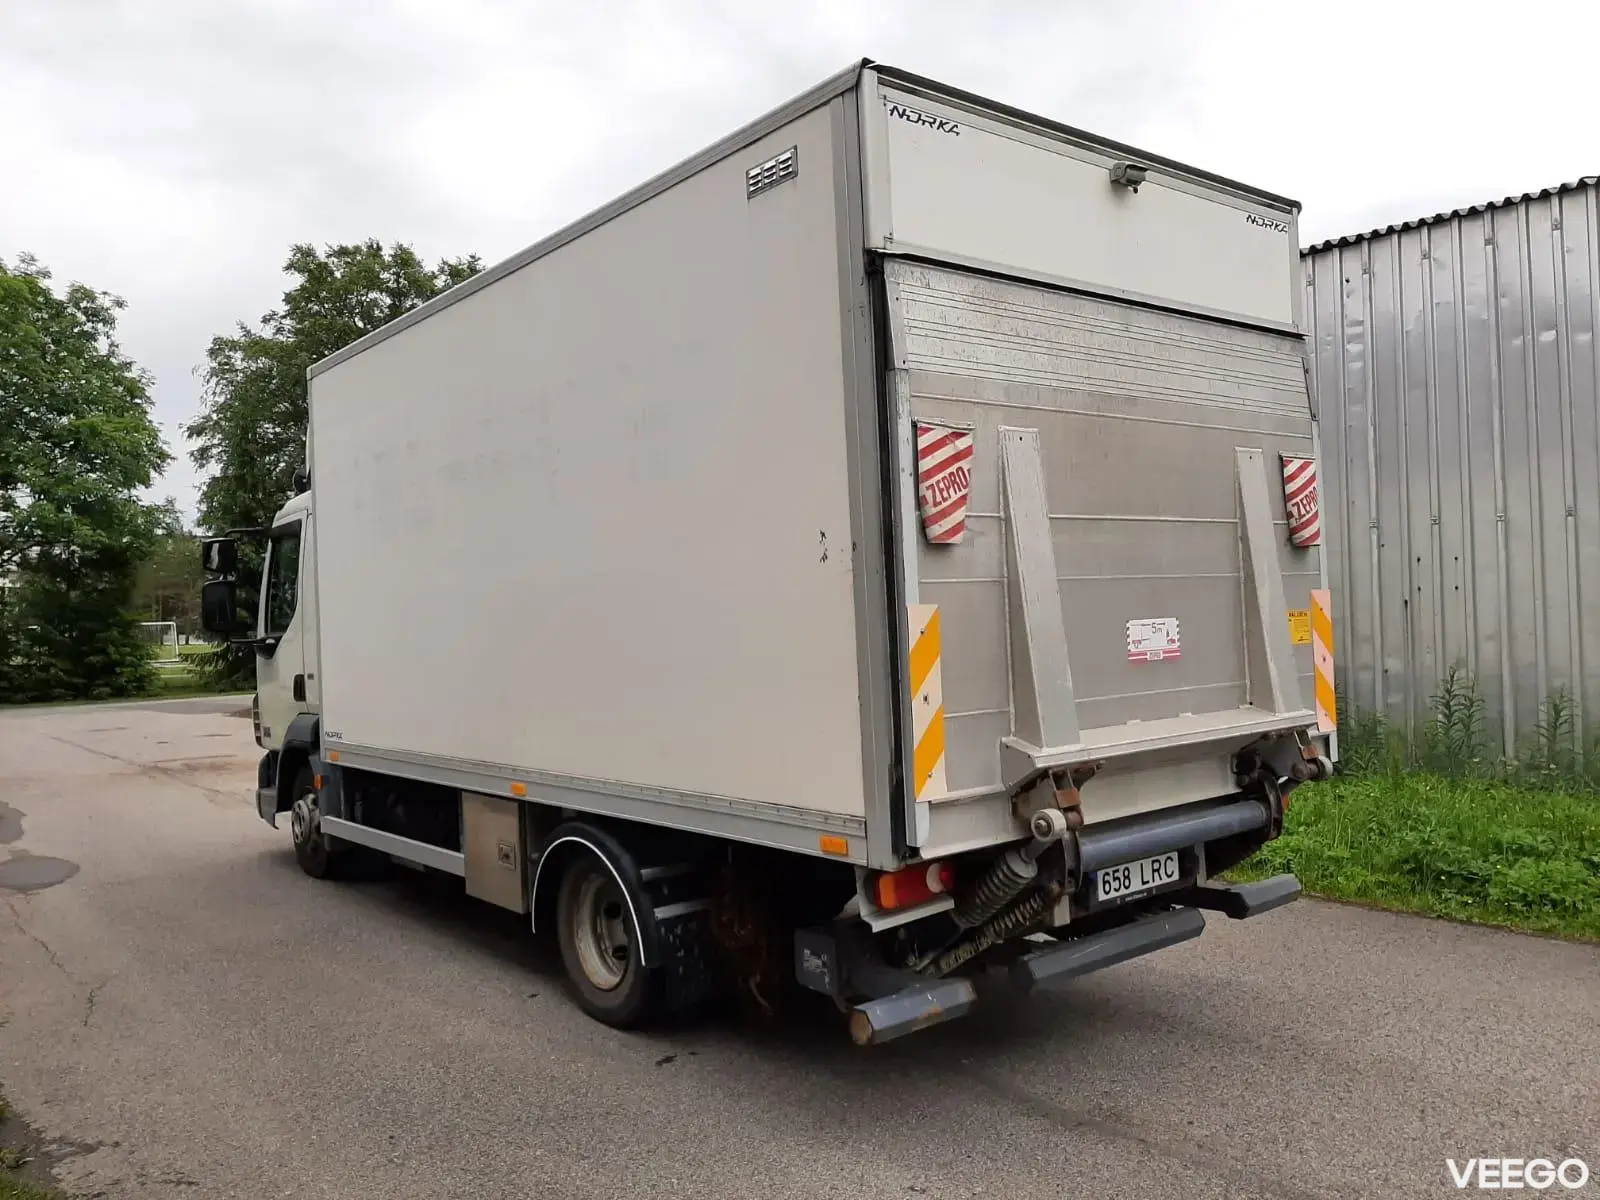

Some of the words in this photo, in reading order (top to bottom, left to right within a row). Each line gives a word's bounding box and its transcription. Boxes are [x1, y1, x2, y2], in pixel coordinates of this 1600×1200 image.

[889, 105, 960, 136] NORKA
[1246, 214, 1288, 234] NORKA
[925, 466, 969, 508] ZEPRO
[1102, 866, 1132, 895] 658
[1140, 856, 1174, 886] LRC
